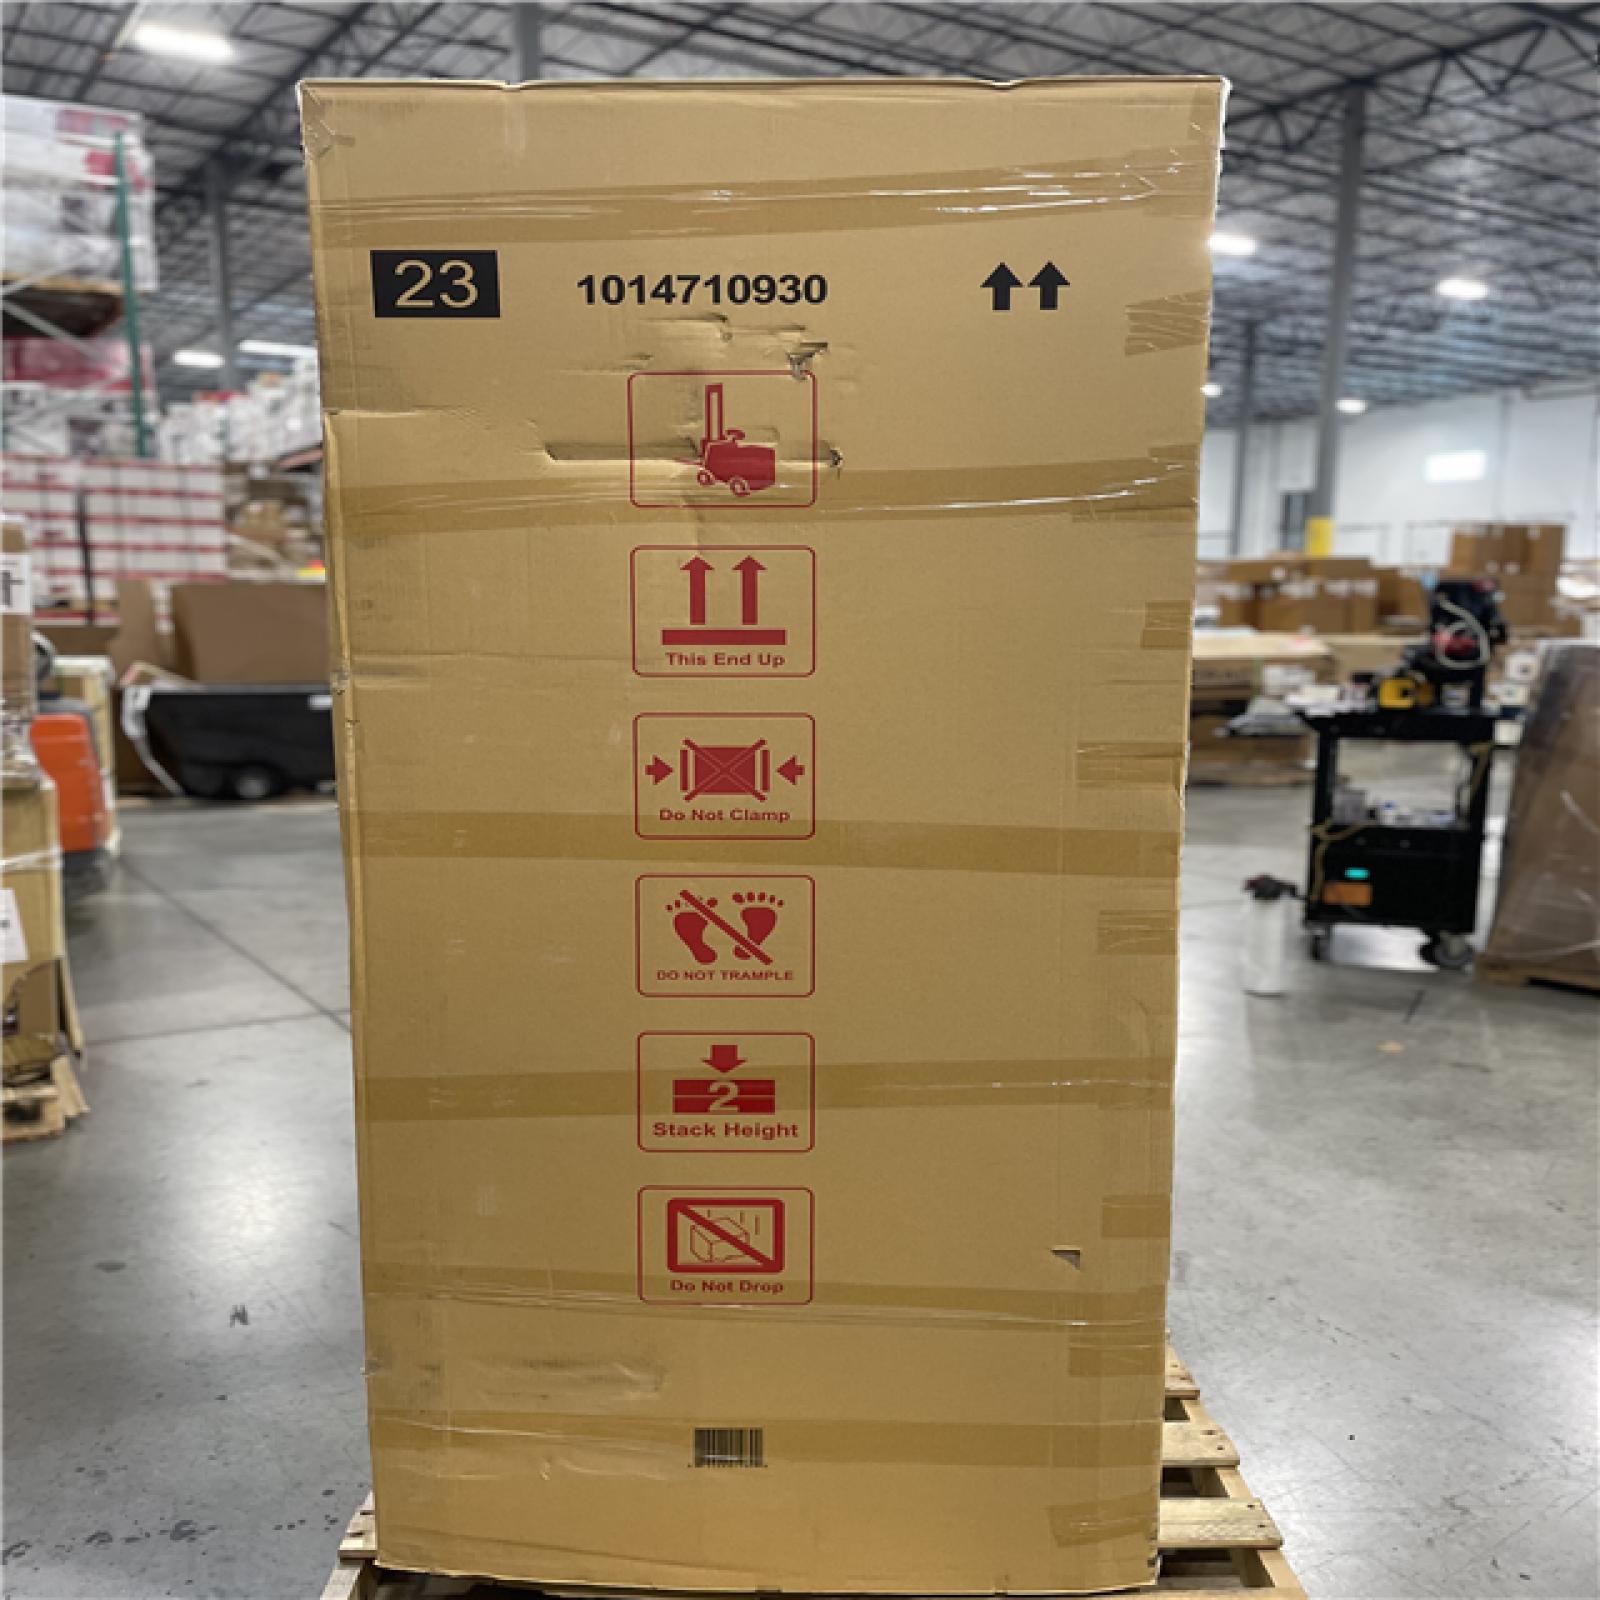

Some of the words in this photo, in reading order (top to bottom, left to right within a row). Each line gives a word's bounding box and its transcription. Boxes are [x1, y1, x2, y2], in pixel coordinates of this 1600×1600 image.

[394, 260, 479, 309] 23
[577, 273, 828, 305] 1014710930
[666, 652, 707, 666] This
[714, 652, 751, 666] End
[758, 652, 786, 668] Up
[660, 809, 685, 822] Do
[692, 809, 724, 822] Not
[730, 809, 790, 823] Clamp
[656, 969, 679, 981] DO
[684, 969, 715, 981] NOT
[720, 969, 794, 981] TRAMPLE
[707, 1081, 740, 1112] 2
[652, 1122, 716, 1138] Stack
[723, 1122, 799, 1140] Height
[670, 1279, 696, 1293] Do
[701, 1279, 734, 1293] Not
[739, 1279, 784, 1295] Drop
